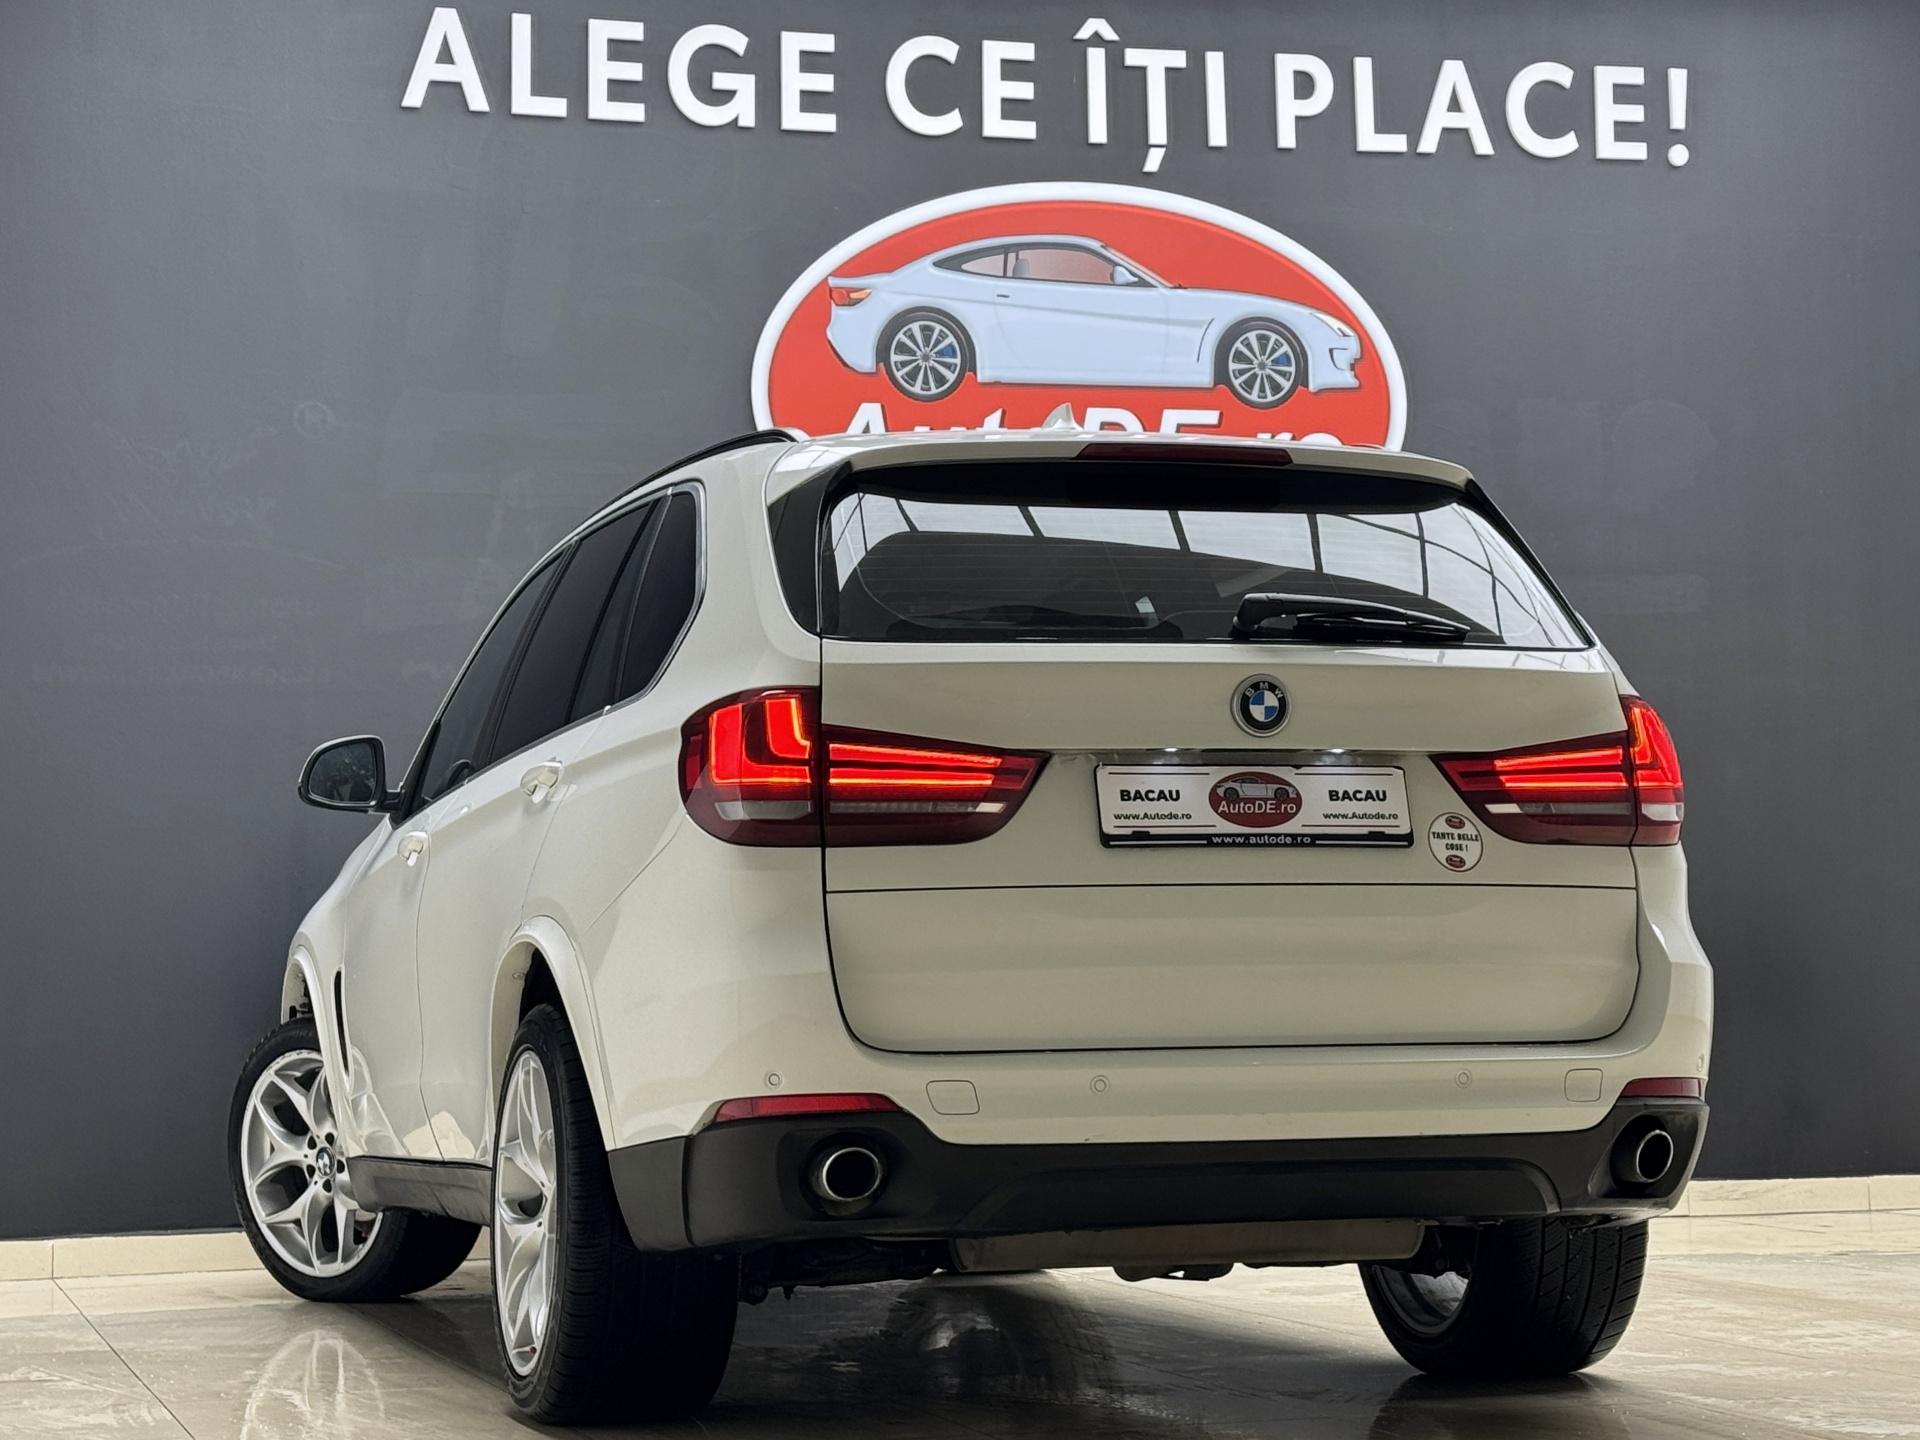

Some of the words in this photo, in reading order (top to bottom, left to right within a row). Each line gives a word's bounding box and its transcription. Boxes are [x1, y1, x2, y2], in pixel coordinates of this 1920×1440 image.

[400, 6, 837, 133] ALEGE
[885, 34, 1037, 141] CE
[1273, 52, 1691, 167] PLACE!
[1119, 789, 1181, 802] BACAU
[1328, 789, 1387, 802] BACAU
[1217, 799, 1297, 814] AutoDE.ro
[1113, 811, 1192, 820] www.Autode.ro
[1322, 811, 1399, 820] www.Autode.ro
[1211, 834, 1311, 844] www.autode.ro
